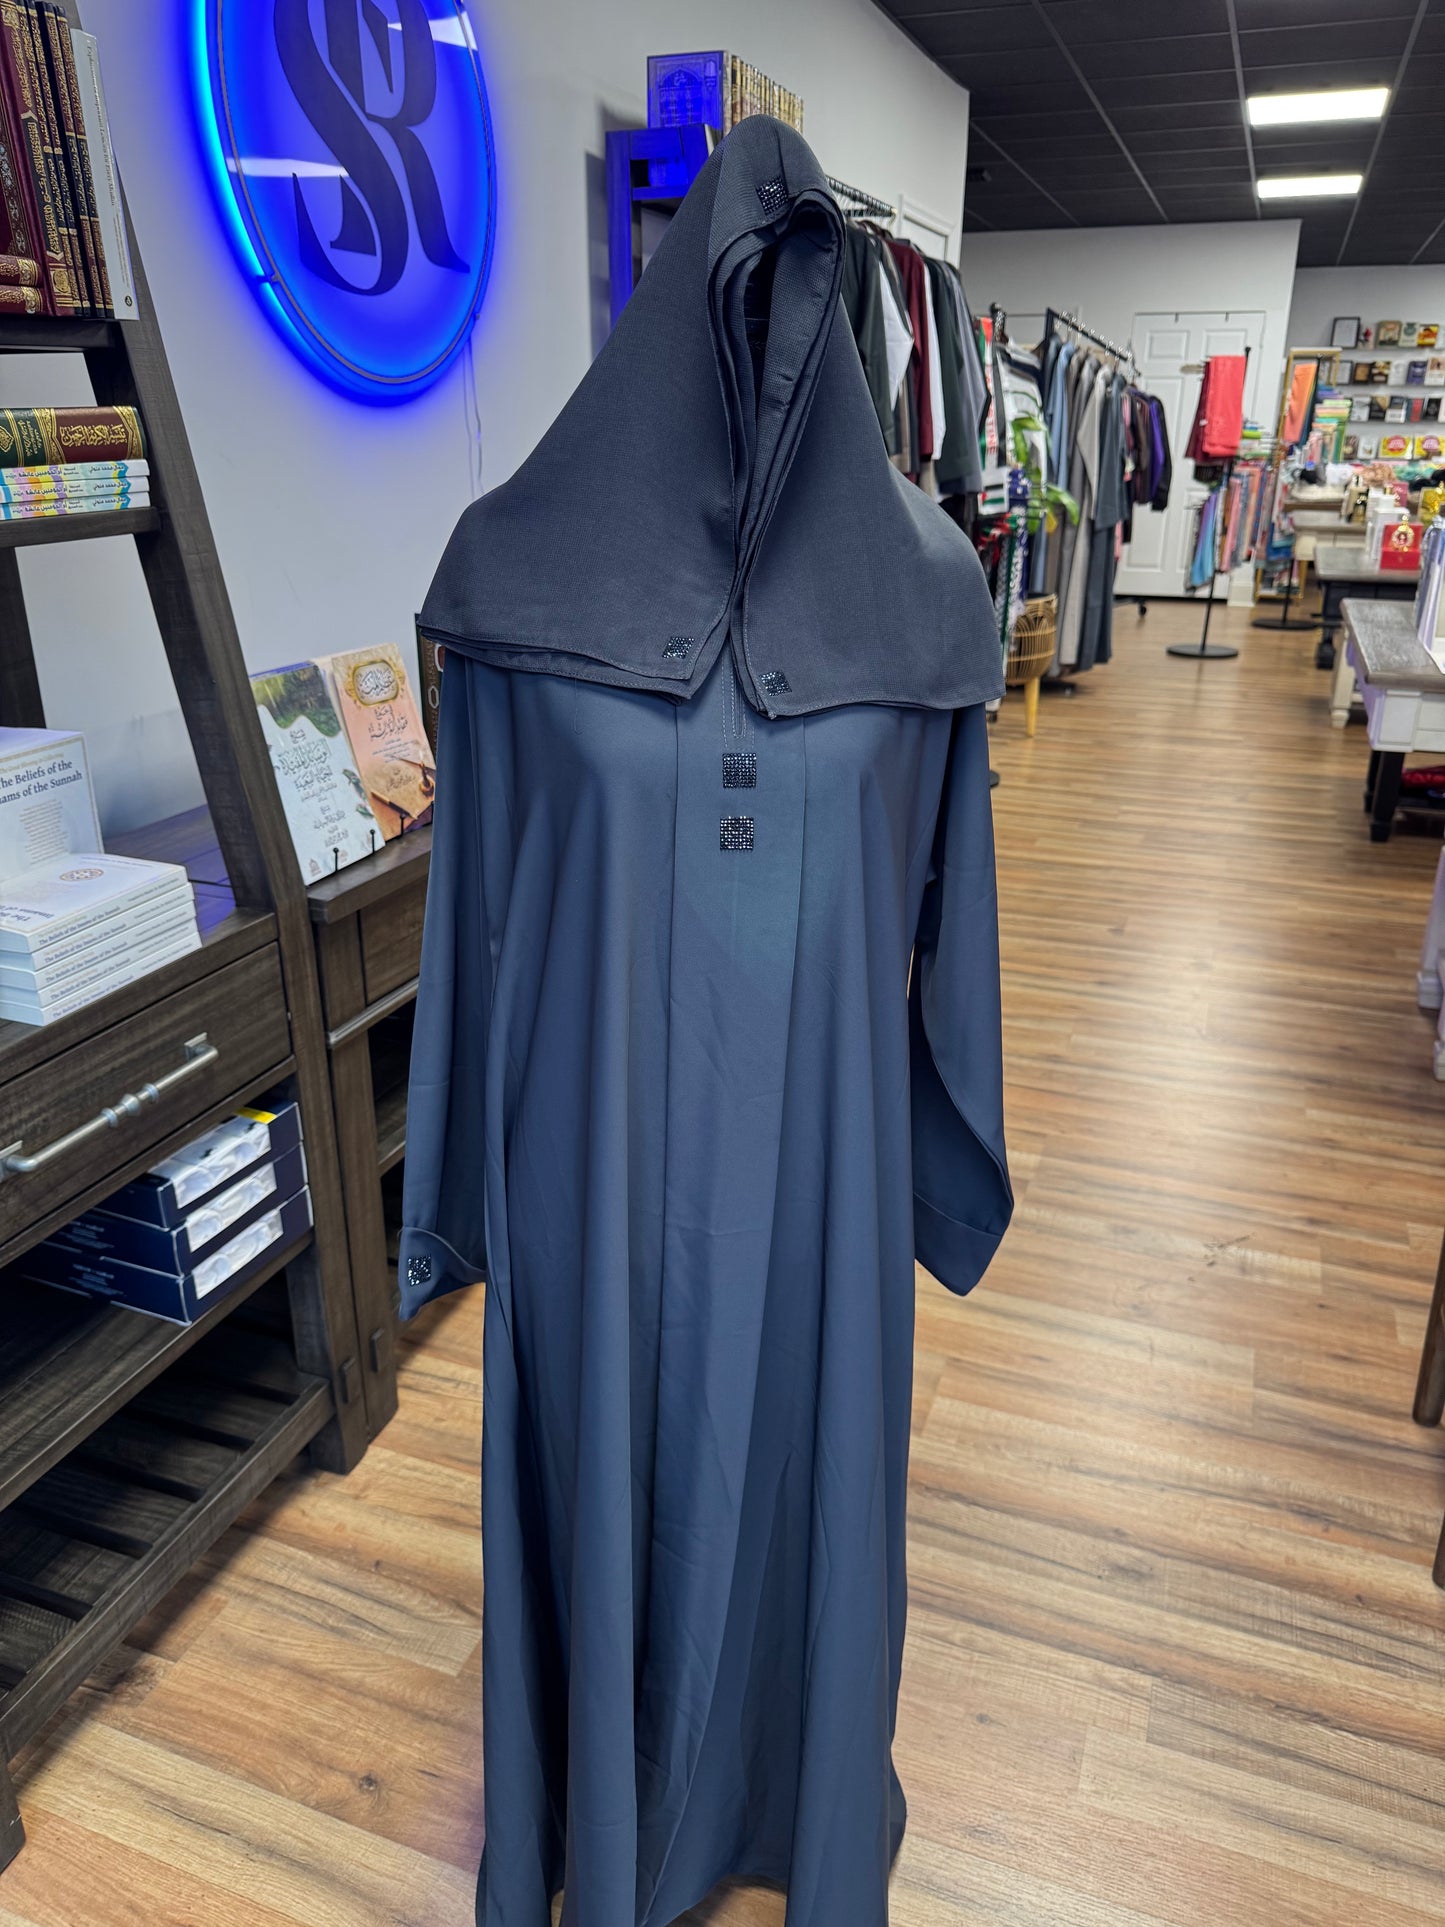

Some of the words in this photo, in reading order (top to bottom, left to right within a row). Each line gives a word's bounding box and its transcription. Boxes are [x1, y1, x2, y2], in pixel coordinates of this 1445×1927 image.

[14, 768, 46, 783] Beliefs
[47, 762, 57, 775] of
[58, 760, 73, 773] the
[22, 785, 32, 797] of
[34, 781, 49, 794] the
[50, 771, 83, 788] Sunnah
